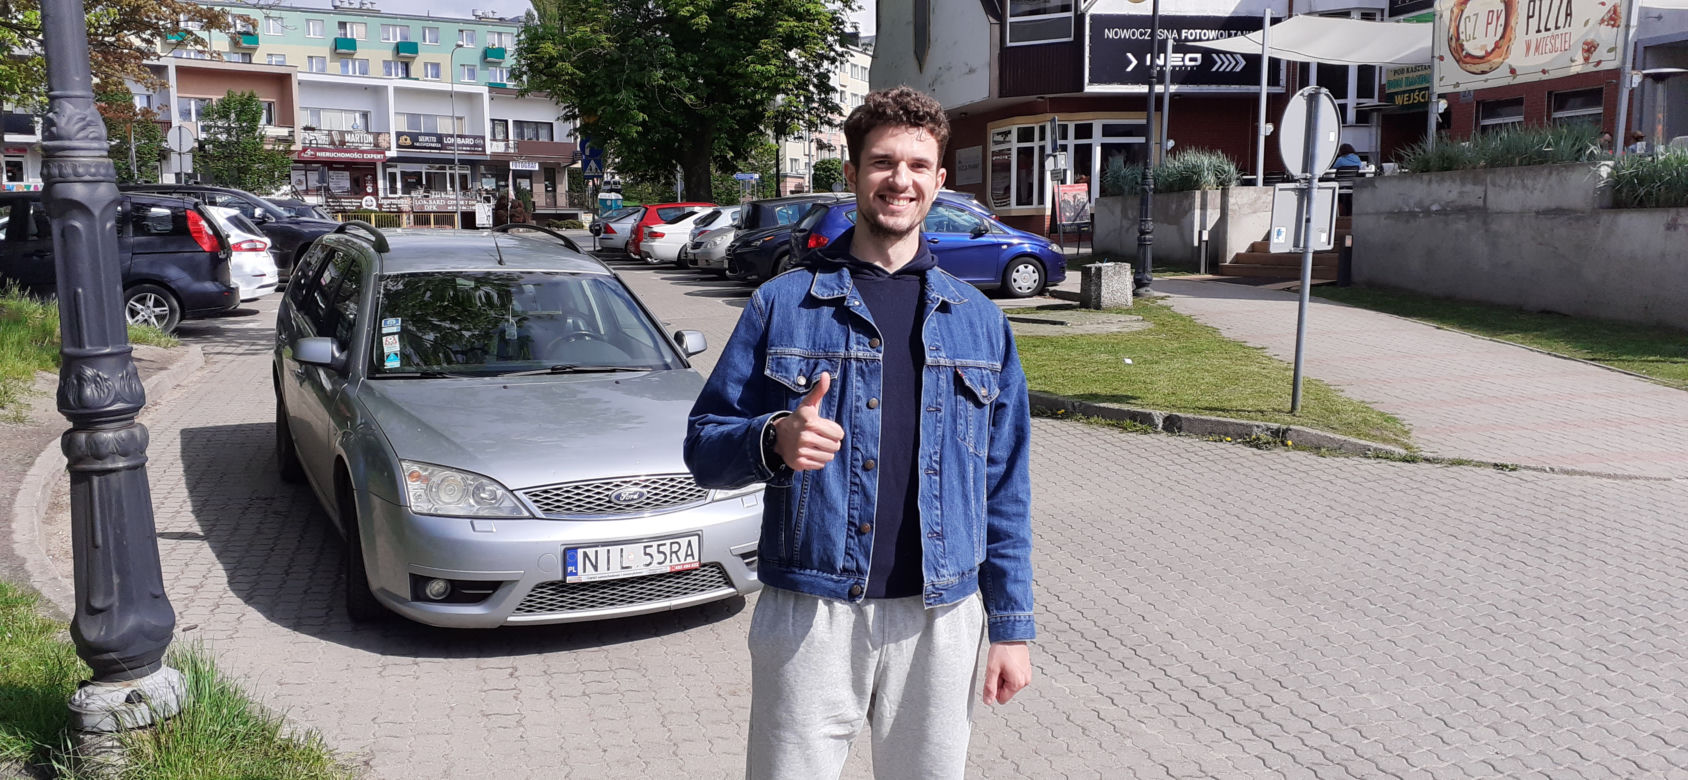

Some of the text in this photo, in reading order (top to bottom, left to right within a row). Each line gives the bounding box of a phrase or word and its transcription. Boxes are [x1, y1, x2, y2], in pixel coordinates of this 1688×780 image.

[1525, 0, 1573, 35] PIZZA
[1104, 28, 1253, 40] NOWOCZSNA FOTOWOLTA
[1524, 39, 1532, 57] W
[1145, 53, 1202, 66] NEO
[1394, 89, 1429, 104] WEJŚCI
[344, 133, 374, 144] MARTON
[316, 151, 362, 159] NIERUCHOMOŚCI
[619, 491, 640, 502] Ford
[582, 539, 695, 574] NIL 55RA
